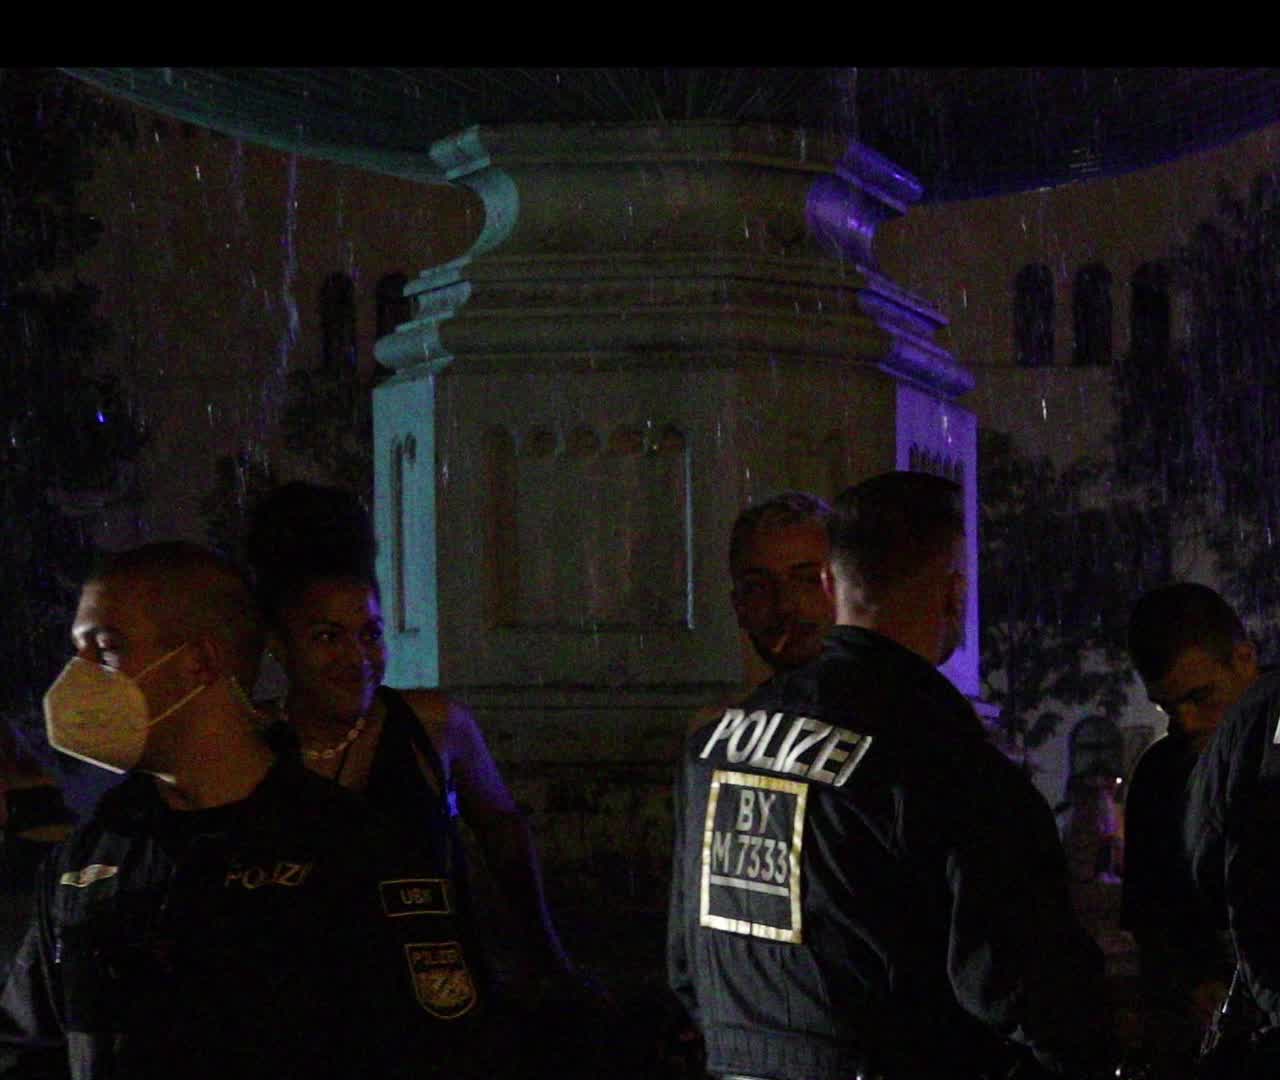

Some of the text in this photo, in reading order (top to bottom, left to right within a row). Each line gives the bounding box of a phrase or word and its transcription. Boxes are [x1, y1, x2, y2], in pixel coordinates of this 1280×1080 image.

[699, 708, 873, 787] POLIZEI
[736, 789, 776, 834] BY
[712, 831, 789, 884] M 7333
